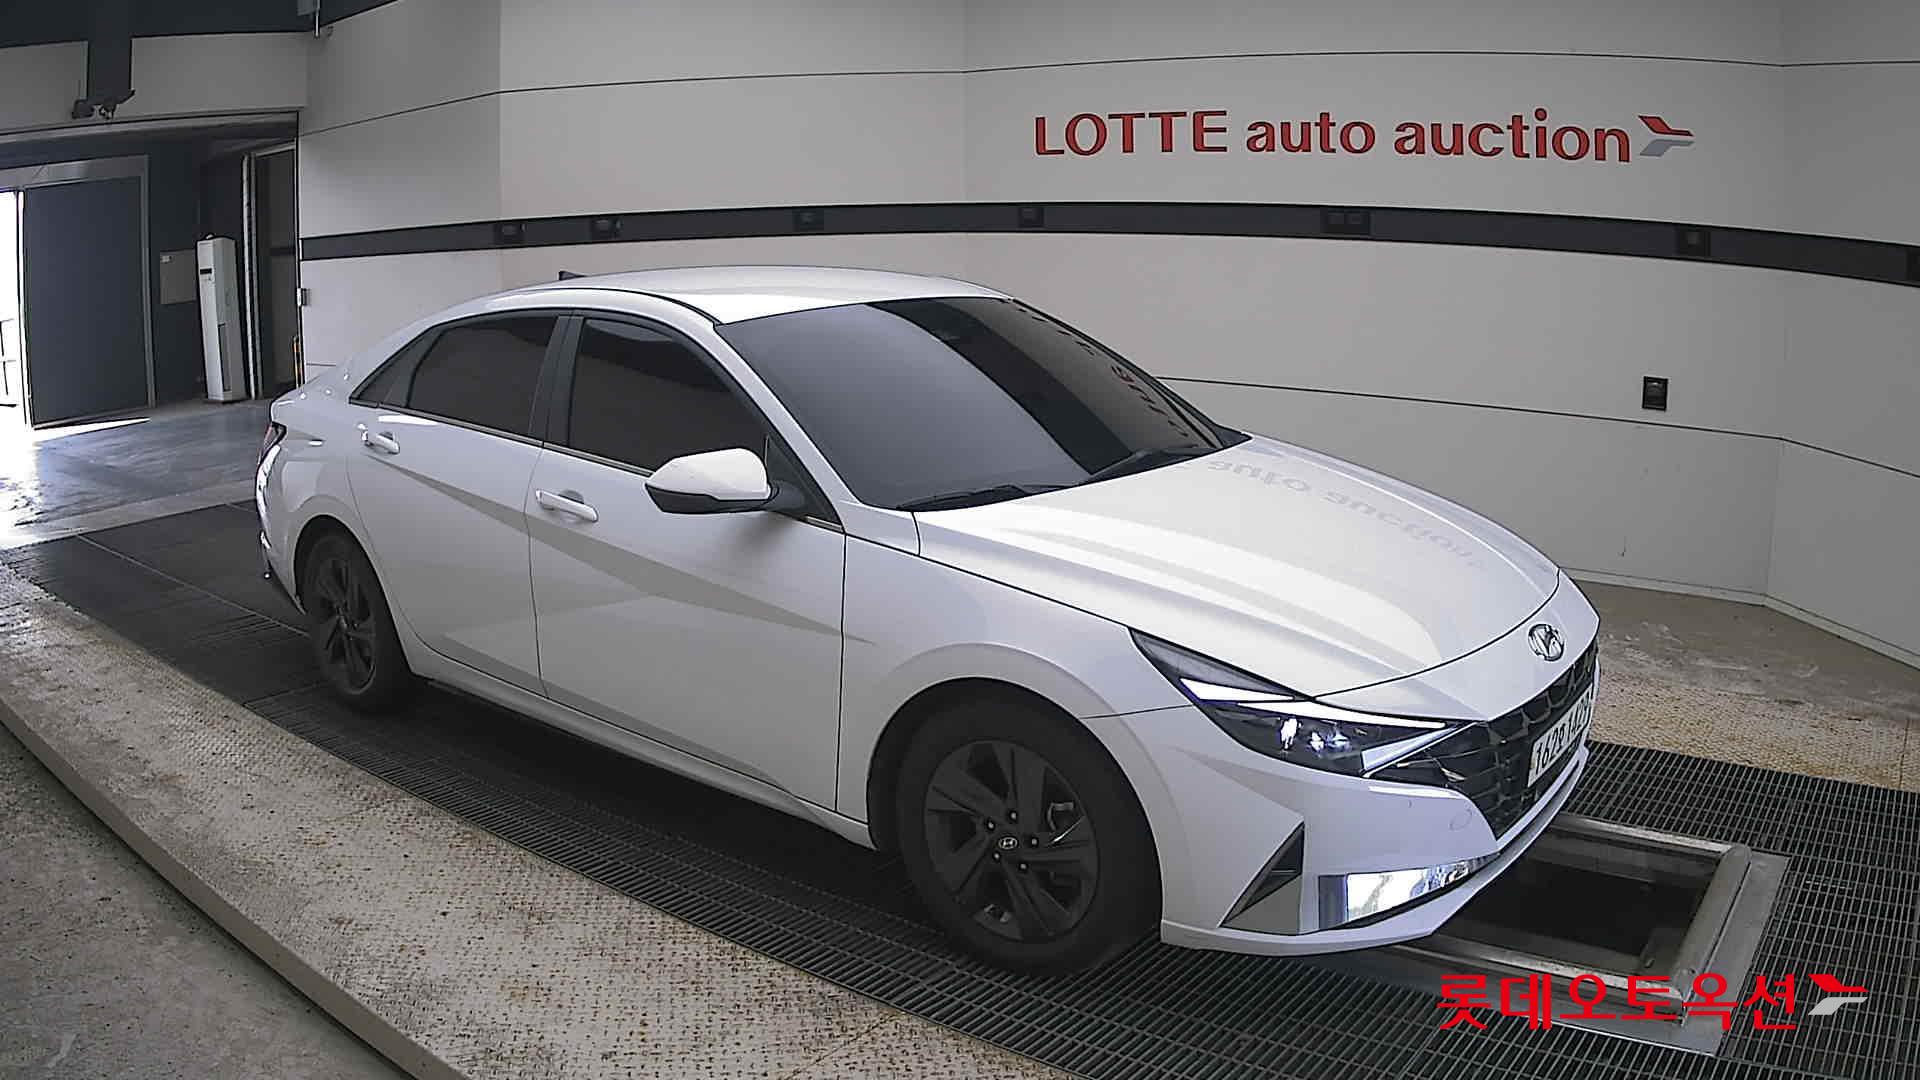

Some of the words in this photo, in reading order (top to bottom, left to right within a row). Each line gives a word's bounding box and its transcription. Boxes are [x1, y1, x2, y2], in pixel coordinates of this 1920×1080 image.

[1035, 110, 1228, 156] LOTTE
[1246, 111, 1376, 154] auto
[1394, 108, 1631, 163] auction
